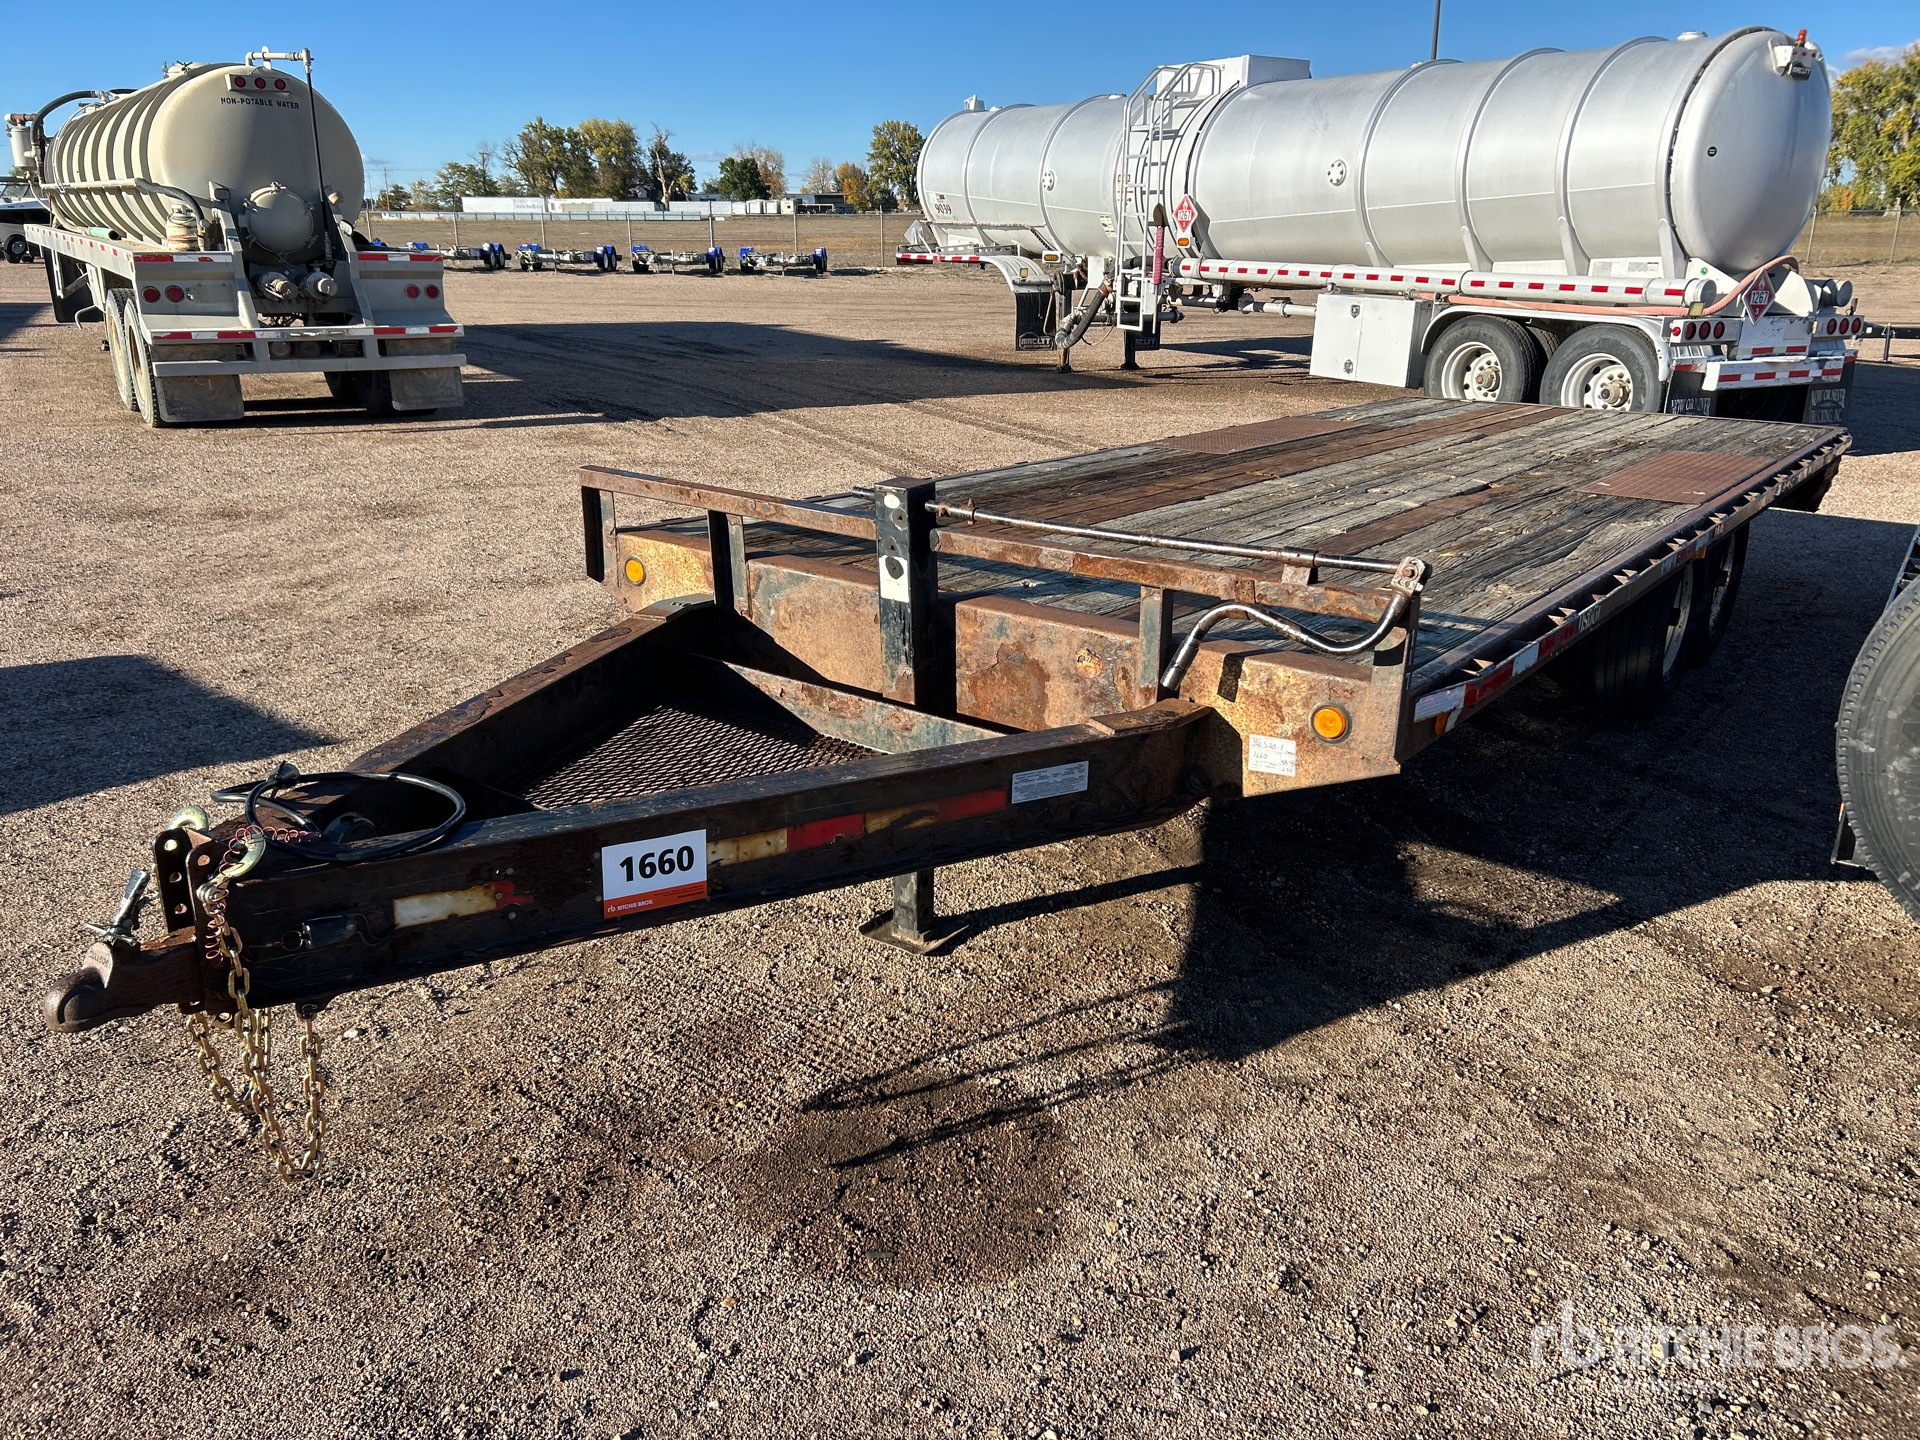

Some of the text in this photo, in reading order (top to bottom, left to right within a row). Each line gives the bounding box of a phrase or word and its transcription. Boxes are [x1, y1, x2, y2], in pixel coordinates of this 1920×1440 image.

[220, 97, 300, 109] NON-POTABLE WATER
[934, 203, 952, 215] 9039
[1179, 210, 1191, 220] 1267
[1752, 291, 1768, 304] 1267
[1755, 307, 1760, 315] 3
[619, 845, 695, 882] 1660
[617, 903, 637, 911] RITCHIE
